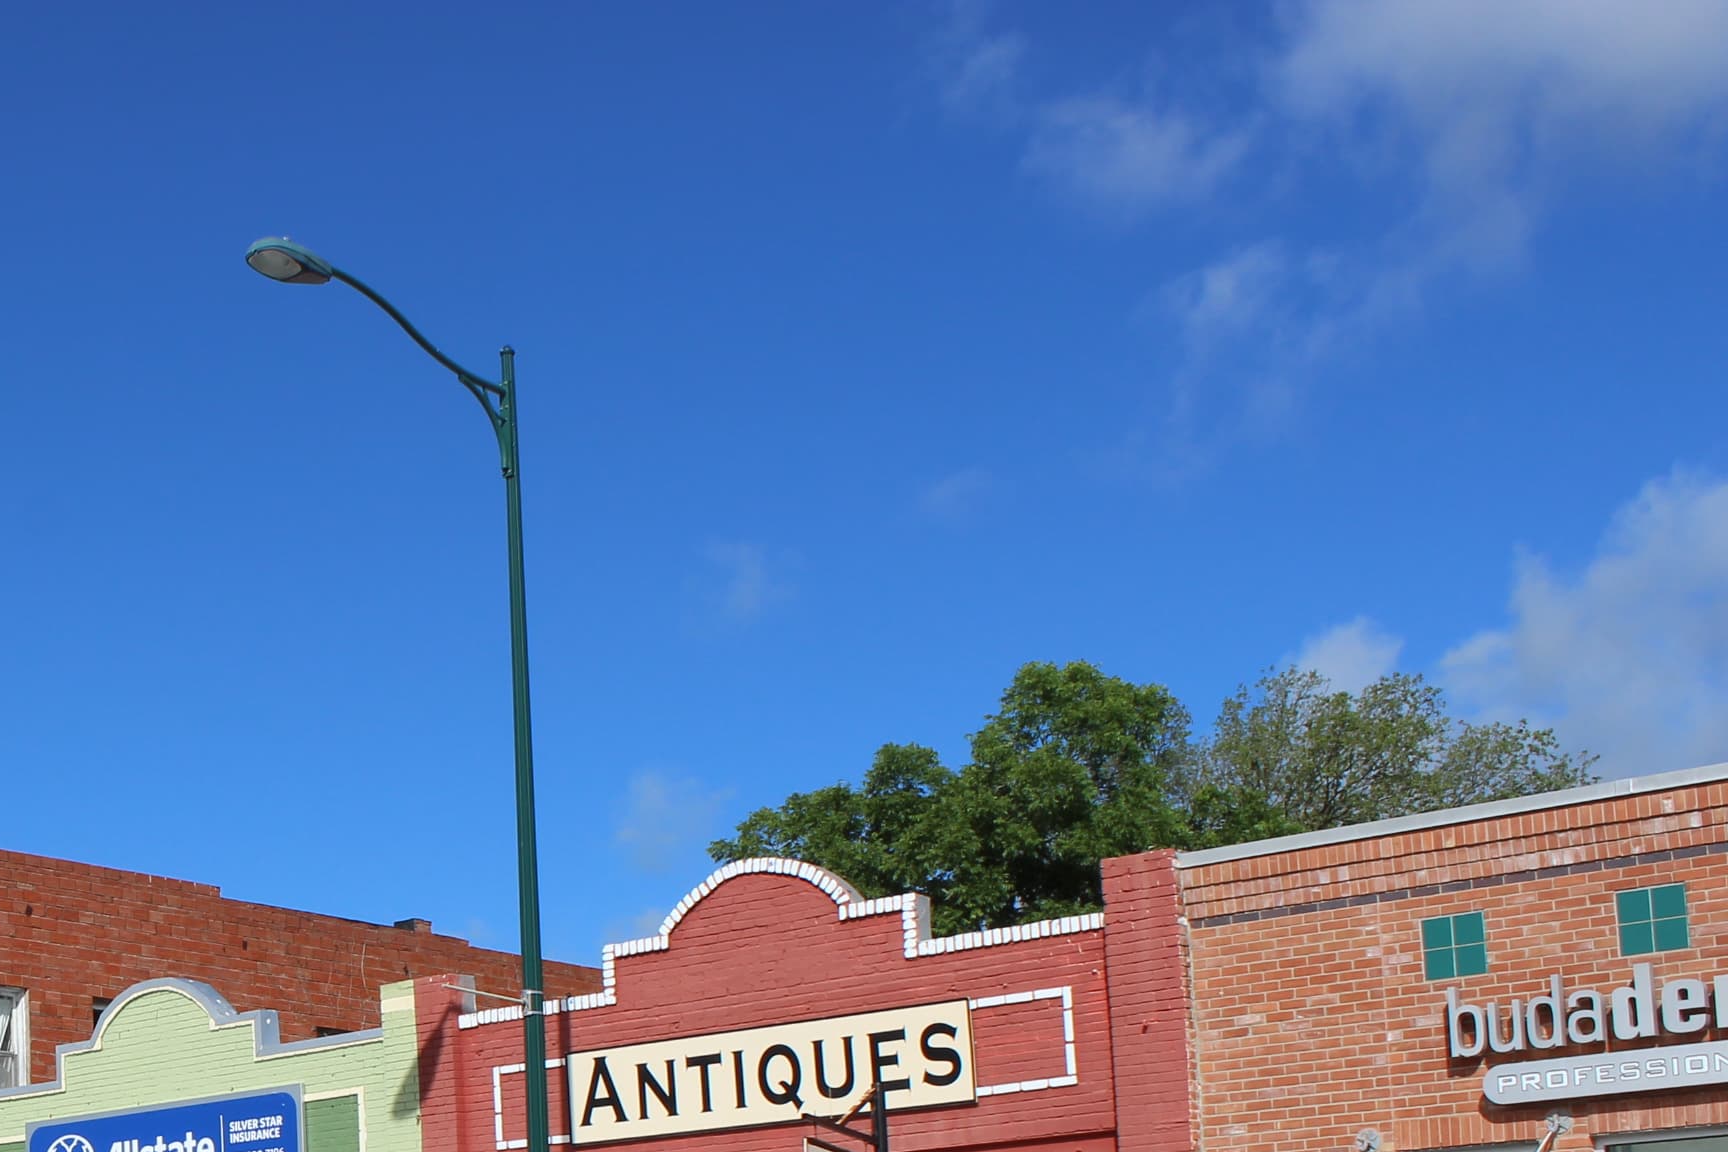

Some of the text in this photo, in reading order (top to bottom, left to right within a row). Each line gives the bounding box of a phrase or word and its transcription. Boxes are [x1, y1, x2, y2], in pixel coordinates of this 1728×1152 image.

[580, 1022, 963, 1127] ANTIQUES
[229, 1115, 283, 1132] SILVER STAR
[229, 1127, 281, 1144] INSURANCE
